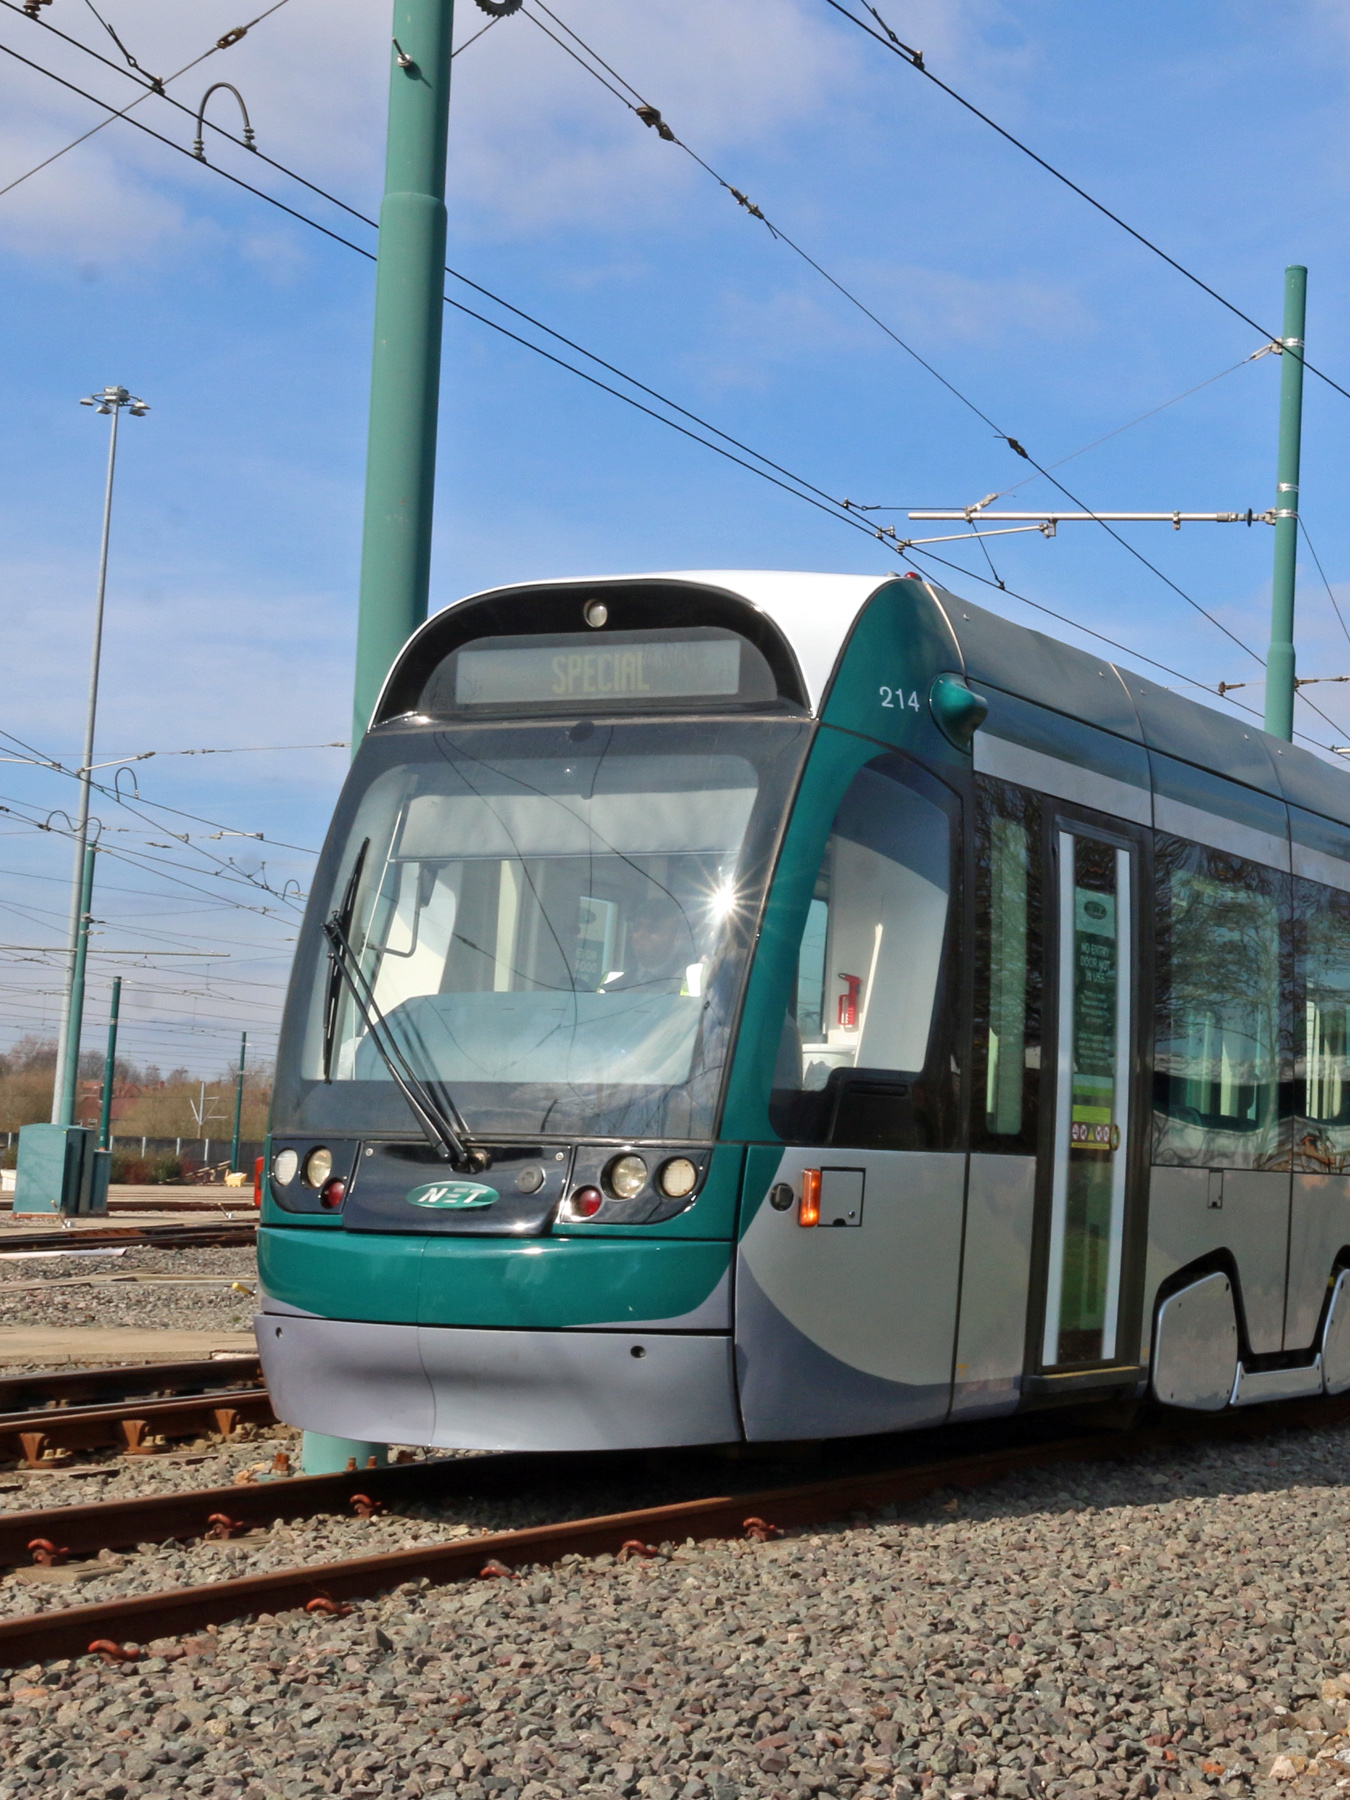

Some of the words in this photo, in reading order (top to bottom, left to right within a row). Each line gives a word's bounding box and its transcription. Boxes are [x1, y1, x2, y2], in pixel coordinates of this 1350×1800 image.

[552, 652, 650, 694] SPECIAL
[879, 686, 920, 712] 214
[1081, 942, 1090, 954] NO
[1091, 944, 1109, 957] ENTRY
[1080, 955, 1098, 968] DOOR
[1099, 960, 1111, 971] NOT
[1093, 971, 1106, 983] USE
[417, 1187, 488, 1204] NET
